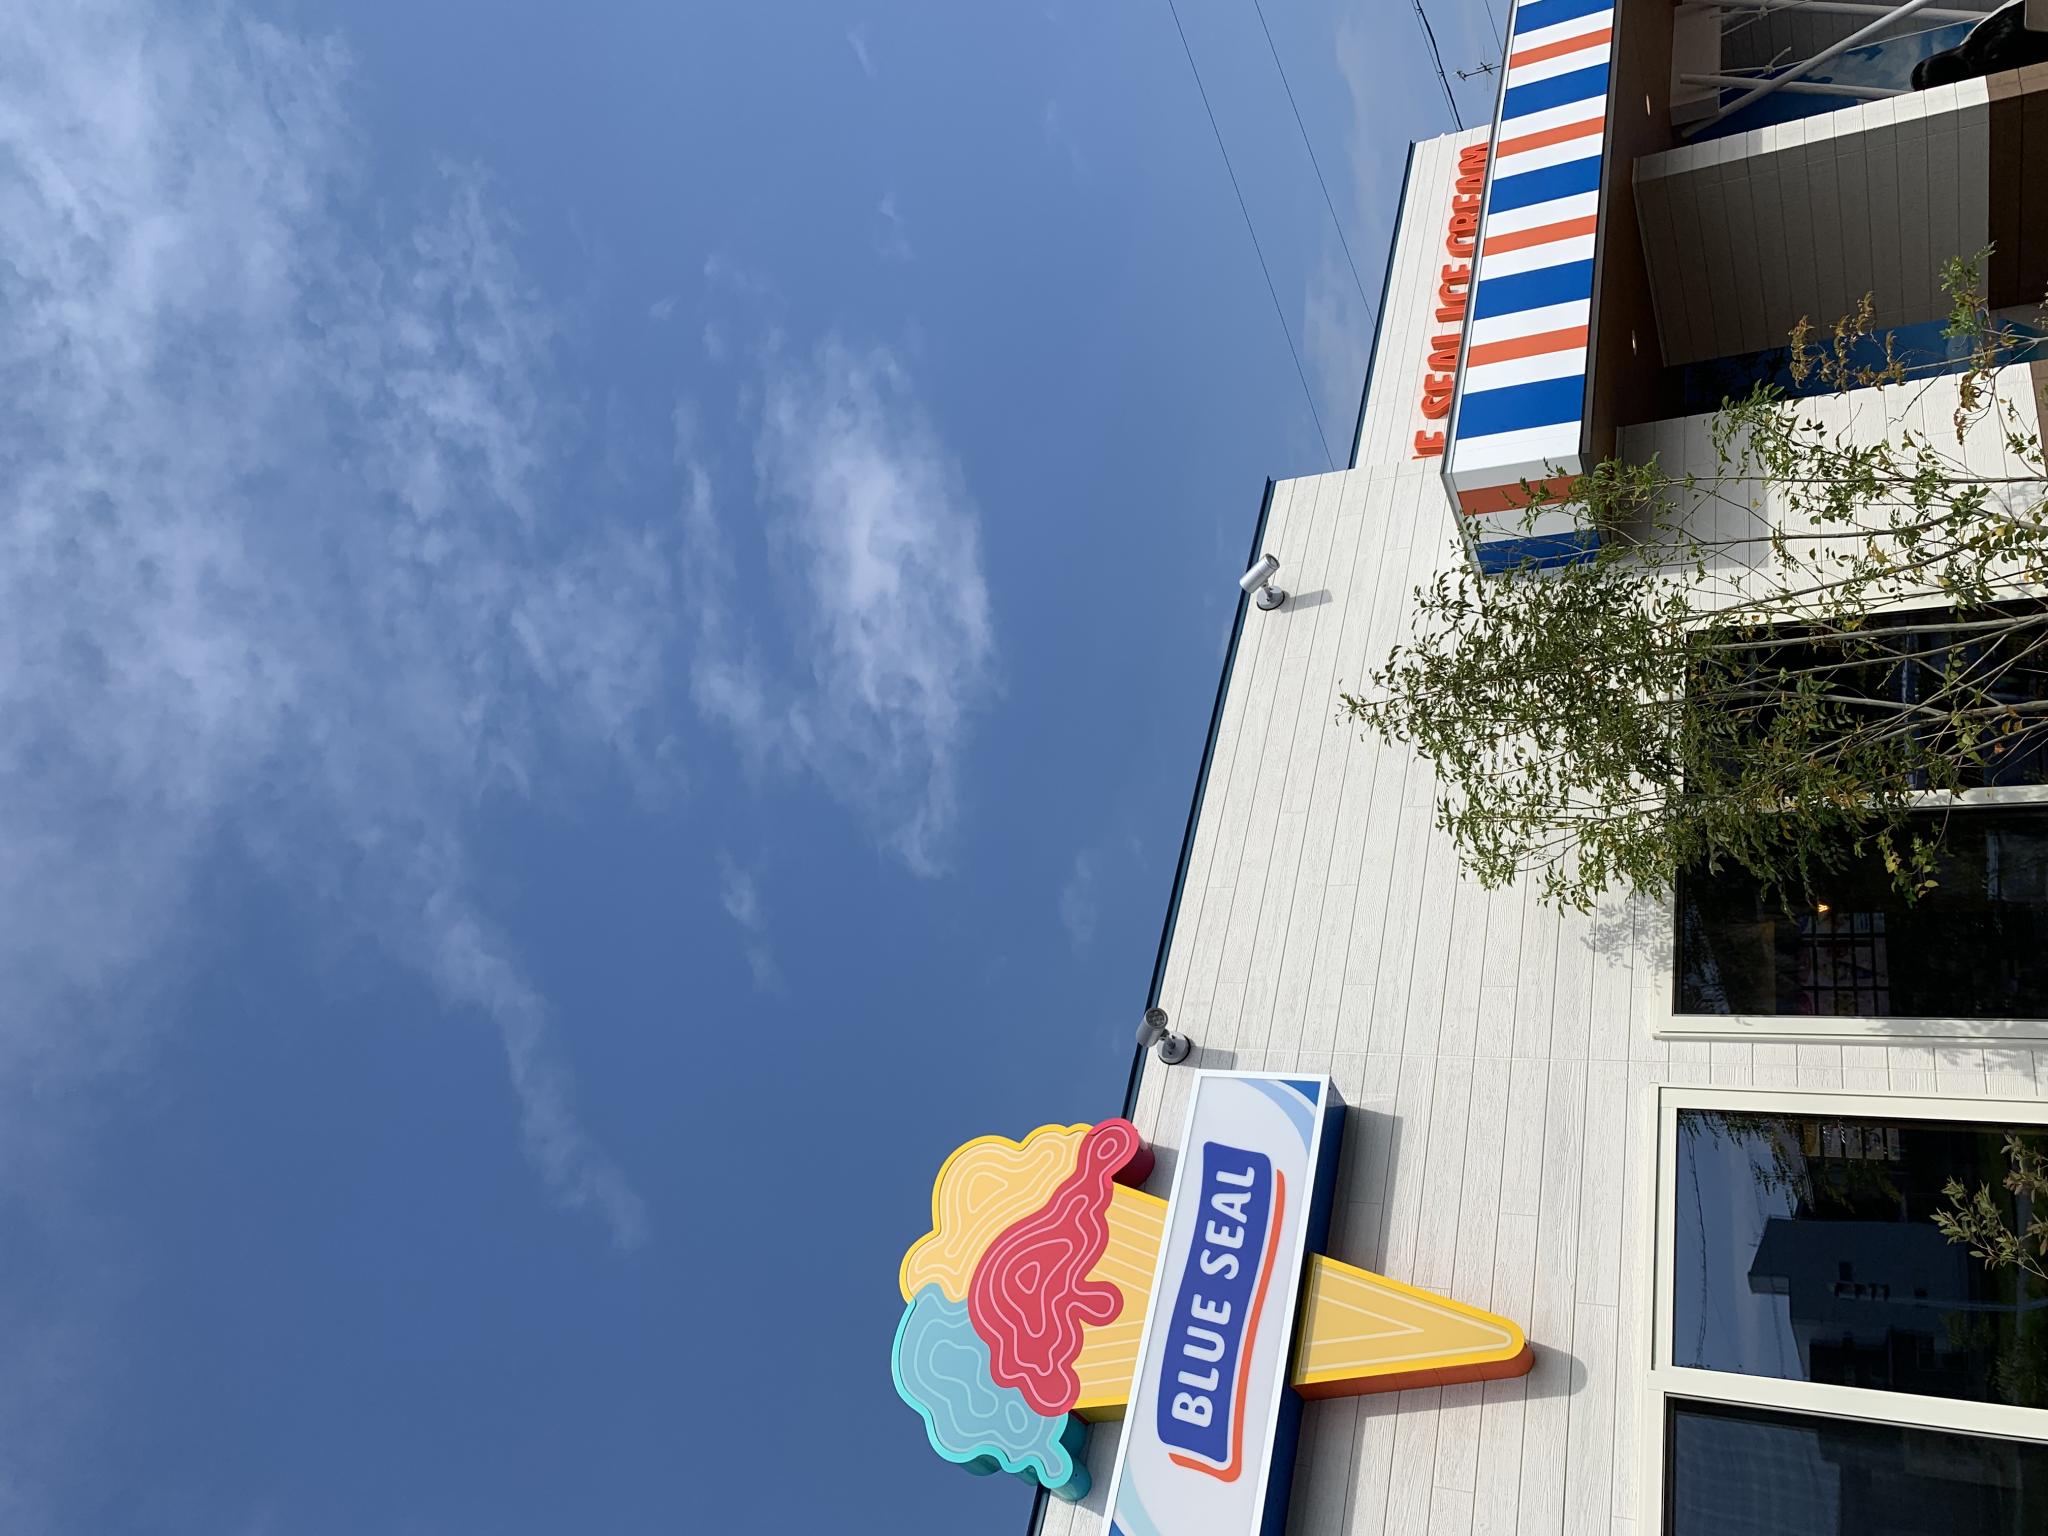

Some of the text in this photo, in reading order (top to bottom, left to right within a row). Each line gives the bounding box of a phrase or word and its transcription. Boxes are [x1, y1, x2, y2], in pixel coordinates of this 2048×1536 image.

[1446, 142, 1489, 258] CREAM
[1435, 264, 1470, 323] ICE
[1412, 430, 1444, 459] E
[1171, 1165, 1255, 1428] BLUE SEAL
